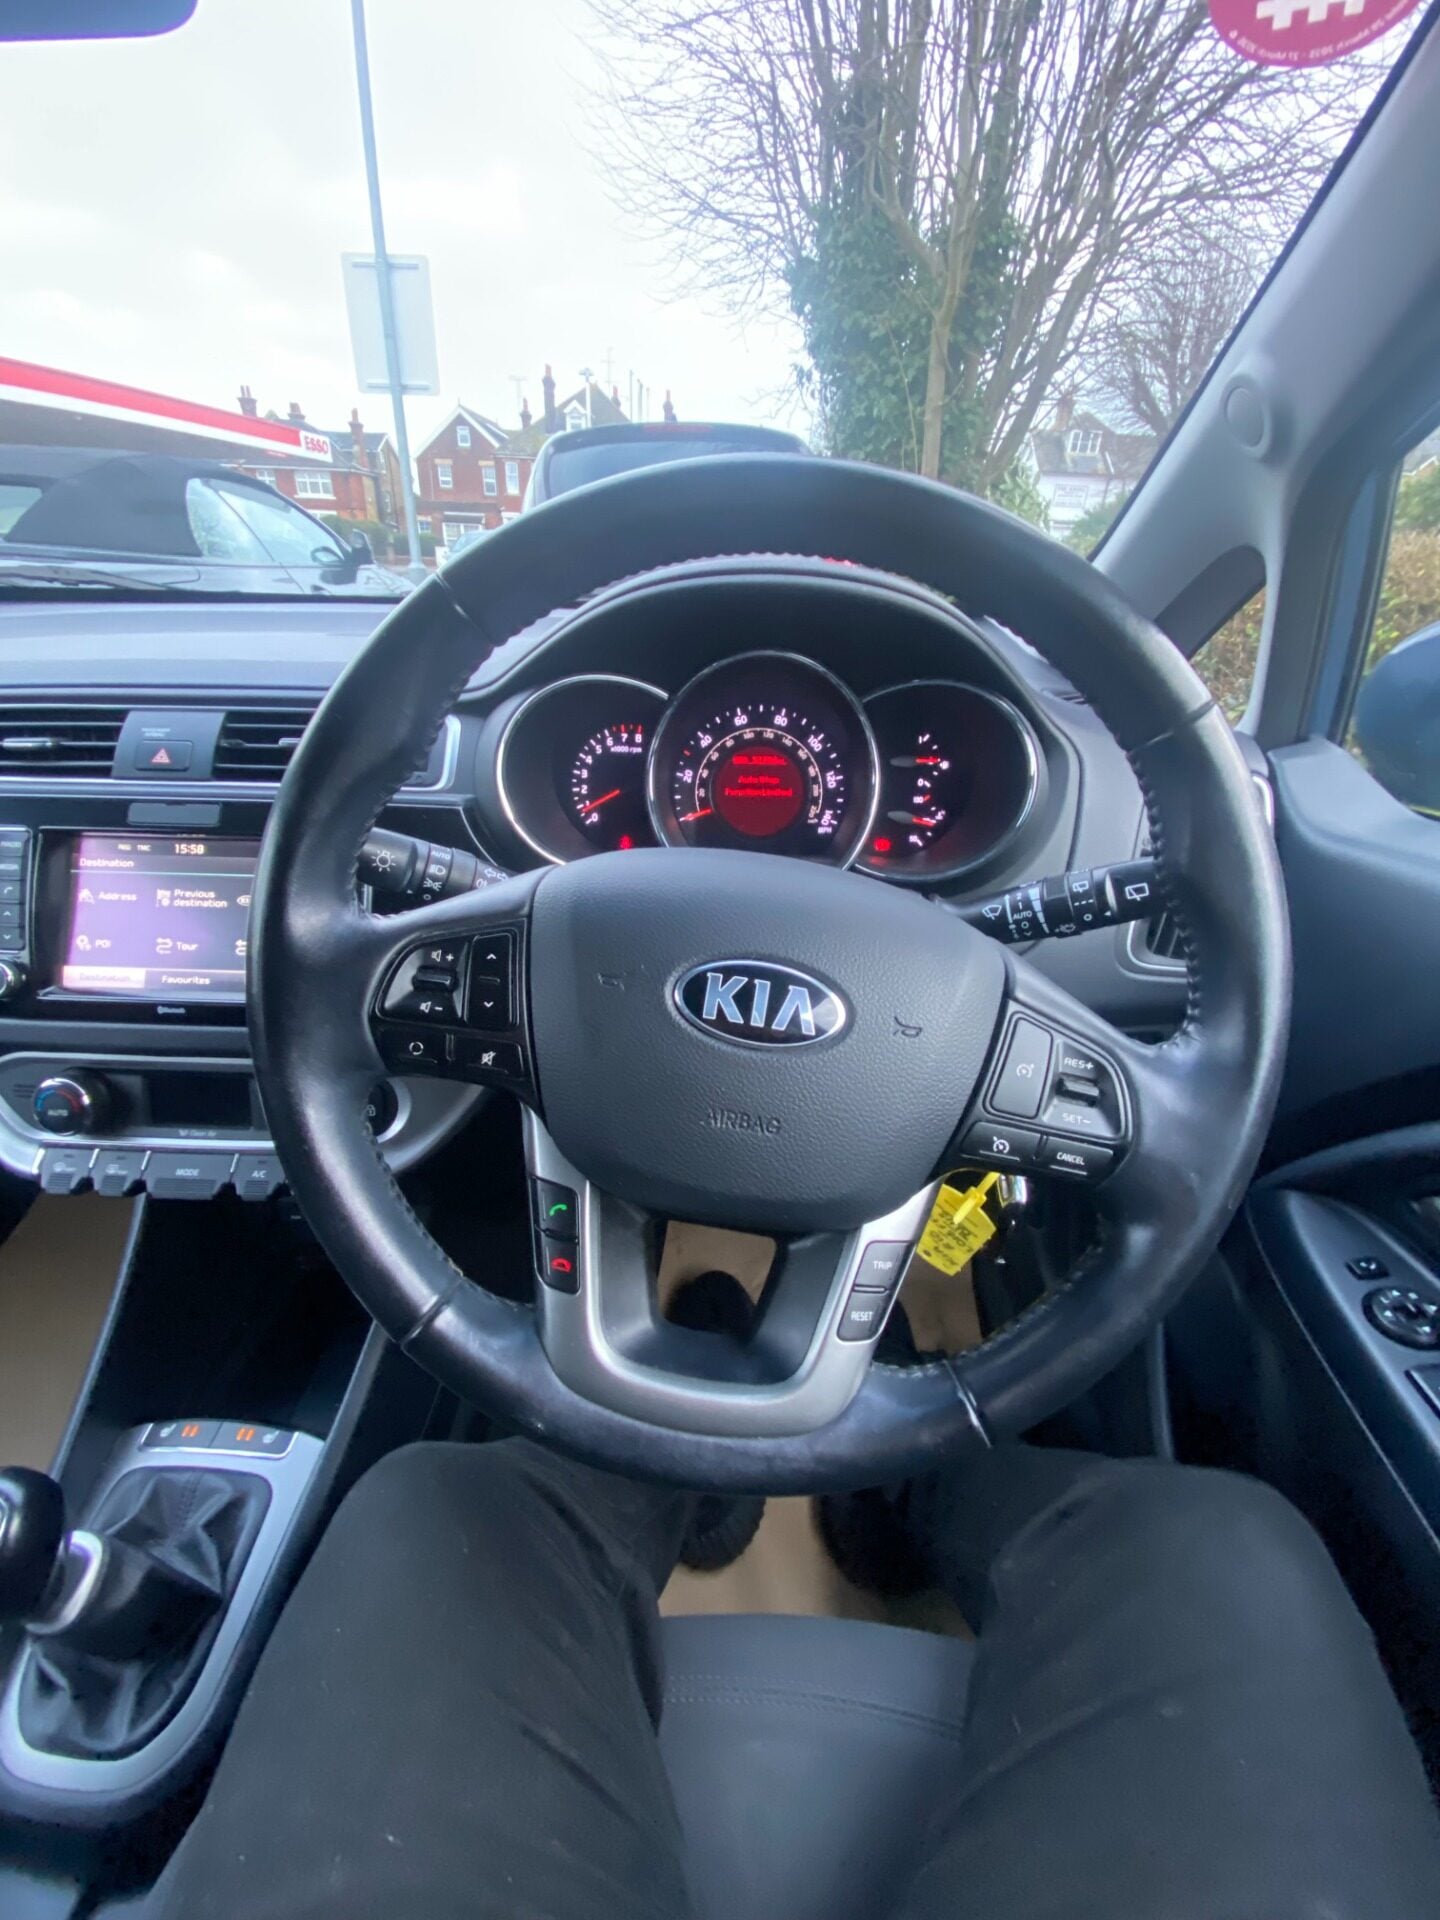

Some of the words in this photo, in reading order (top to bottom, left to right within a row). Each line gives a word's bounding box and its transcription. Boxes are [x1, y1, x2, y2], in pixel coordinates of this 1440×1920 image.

[734, 715, 748, 726] 60
[774, 715, 788, 726] 80
[606, 737, 613, 746] 6
[621, 733, 628, 742] 7
[635, 733, 642, 743] 8
[700, 735, 713, 748] 40
[807, 735, 822, 752] 100
[596, 745, 602, 754] 5
[586, 755, 593, 764] 4
[581, 769, 588, 778] 3
[683, 769, 693, 783] 20
[825, 770, 837, 788] 120
[581, 785, 588, 794] 2
[592, 812, 599, 822] 0
[820, 809, 833, 826] 140
[818, 826, 832, 834] MPH
[432, 850, 451, 860] AUTO
[79, 858, 135, 868] Destination
[98, 891, 137, 902] Address
[174, 888, 216, 899] Previous
[173, 898, 228, 909] destination
[1013, 910, 1033, 920] AUTO
[176, 942, 198, 952] Tour
[162, 975, 211, 985] Favourites
[703, 972, 816, 1036] KIA
[47, 1109, 69, 1117] AUTO
[707, 1108, 781, 1135] AIRBAG
[1056, 1152, 1085, 1165] CANCEL
[175, 1168, 200, 1177] MODE
[251, 1168, 266, 1178] A/C
[872, 1260, 893, 1270] TRIP
[851, 1311, 873, 1321] RESET
